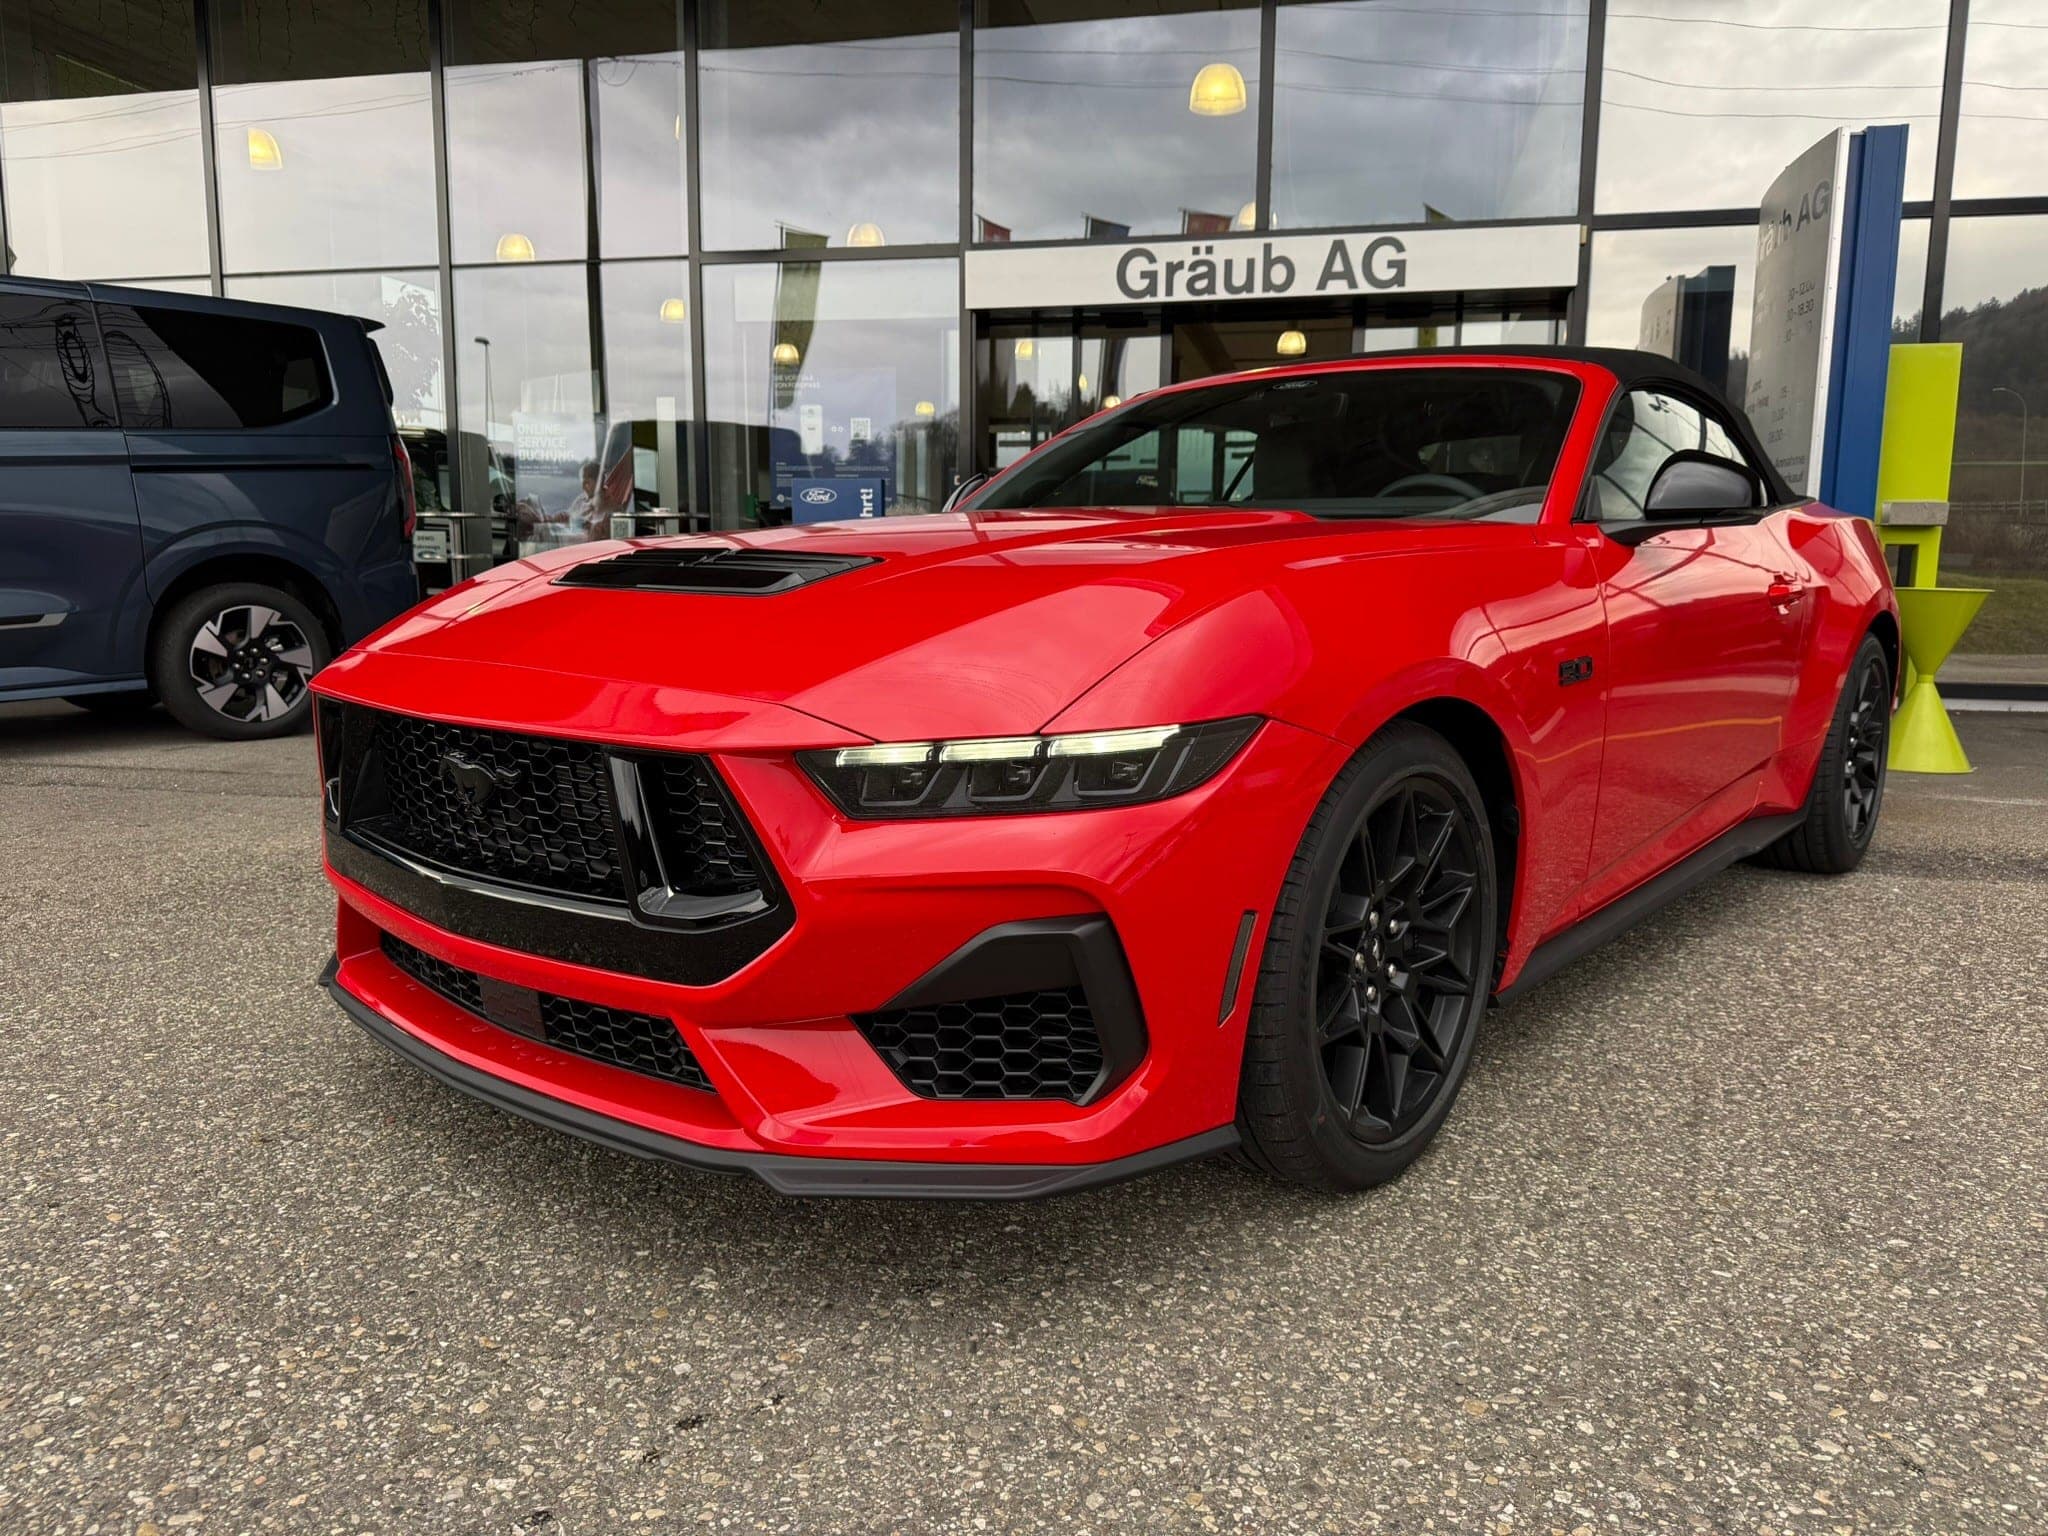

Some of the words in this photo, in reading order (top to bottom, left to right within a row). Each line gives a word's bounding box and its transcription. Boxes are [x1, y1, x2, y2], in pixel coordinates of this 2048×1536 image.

[1796, 180, 1831, 232] AG
[1116, 243, 1295, 299] Gräub
[1316, 235, 1407, 291] AG
[517, 423, 561, 434] ONLINE
[518, 436, 567, 448] SERVICE
[807, 489, 831, 502] Ford
[860, 488, 873, 517] hrt!
